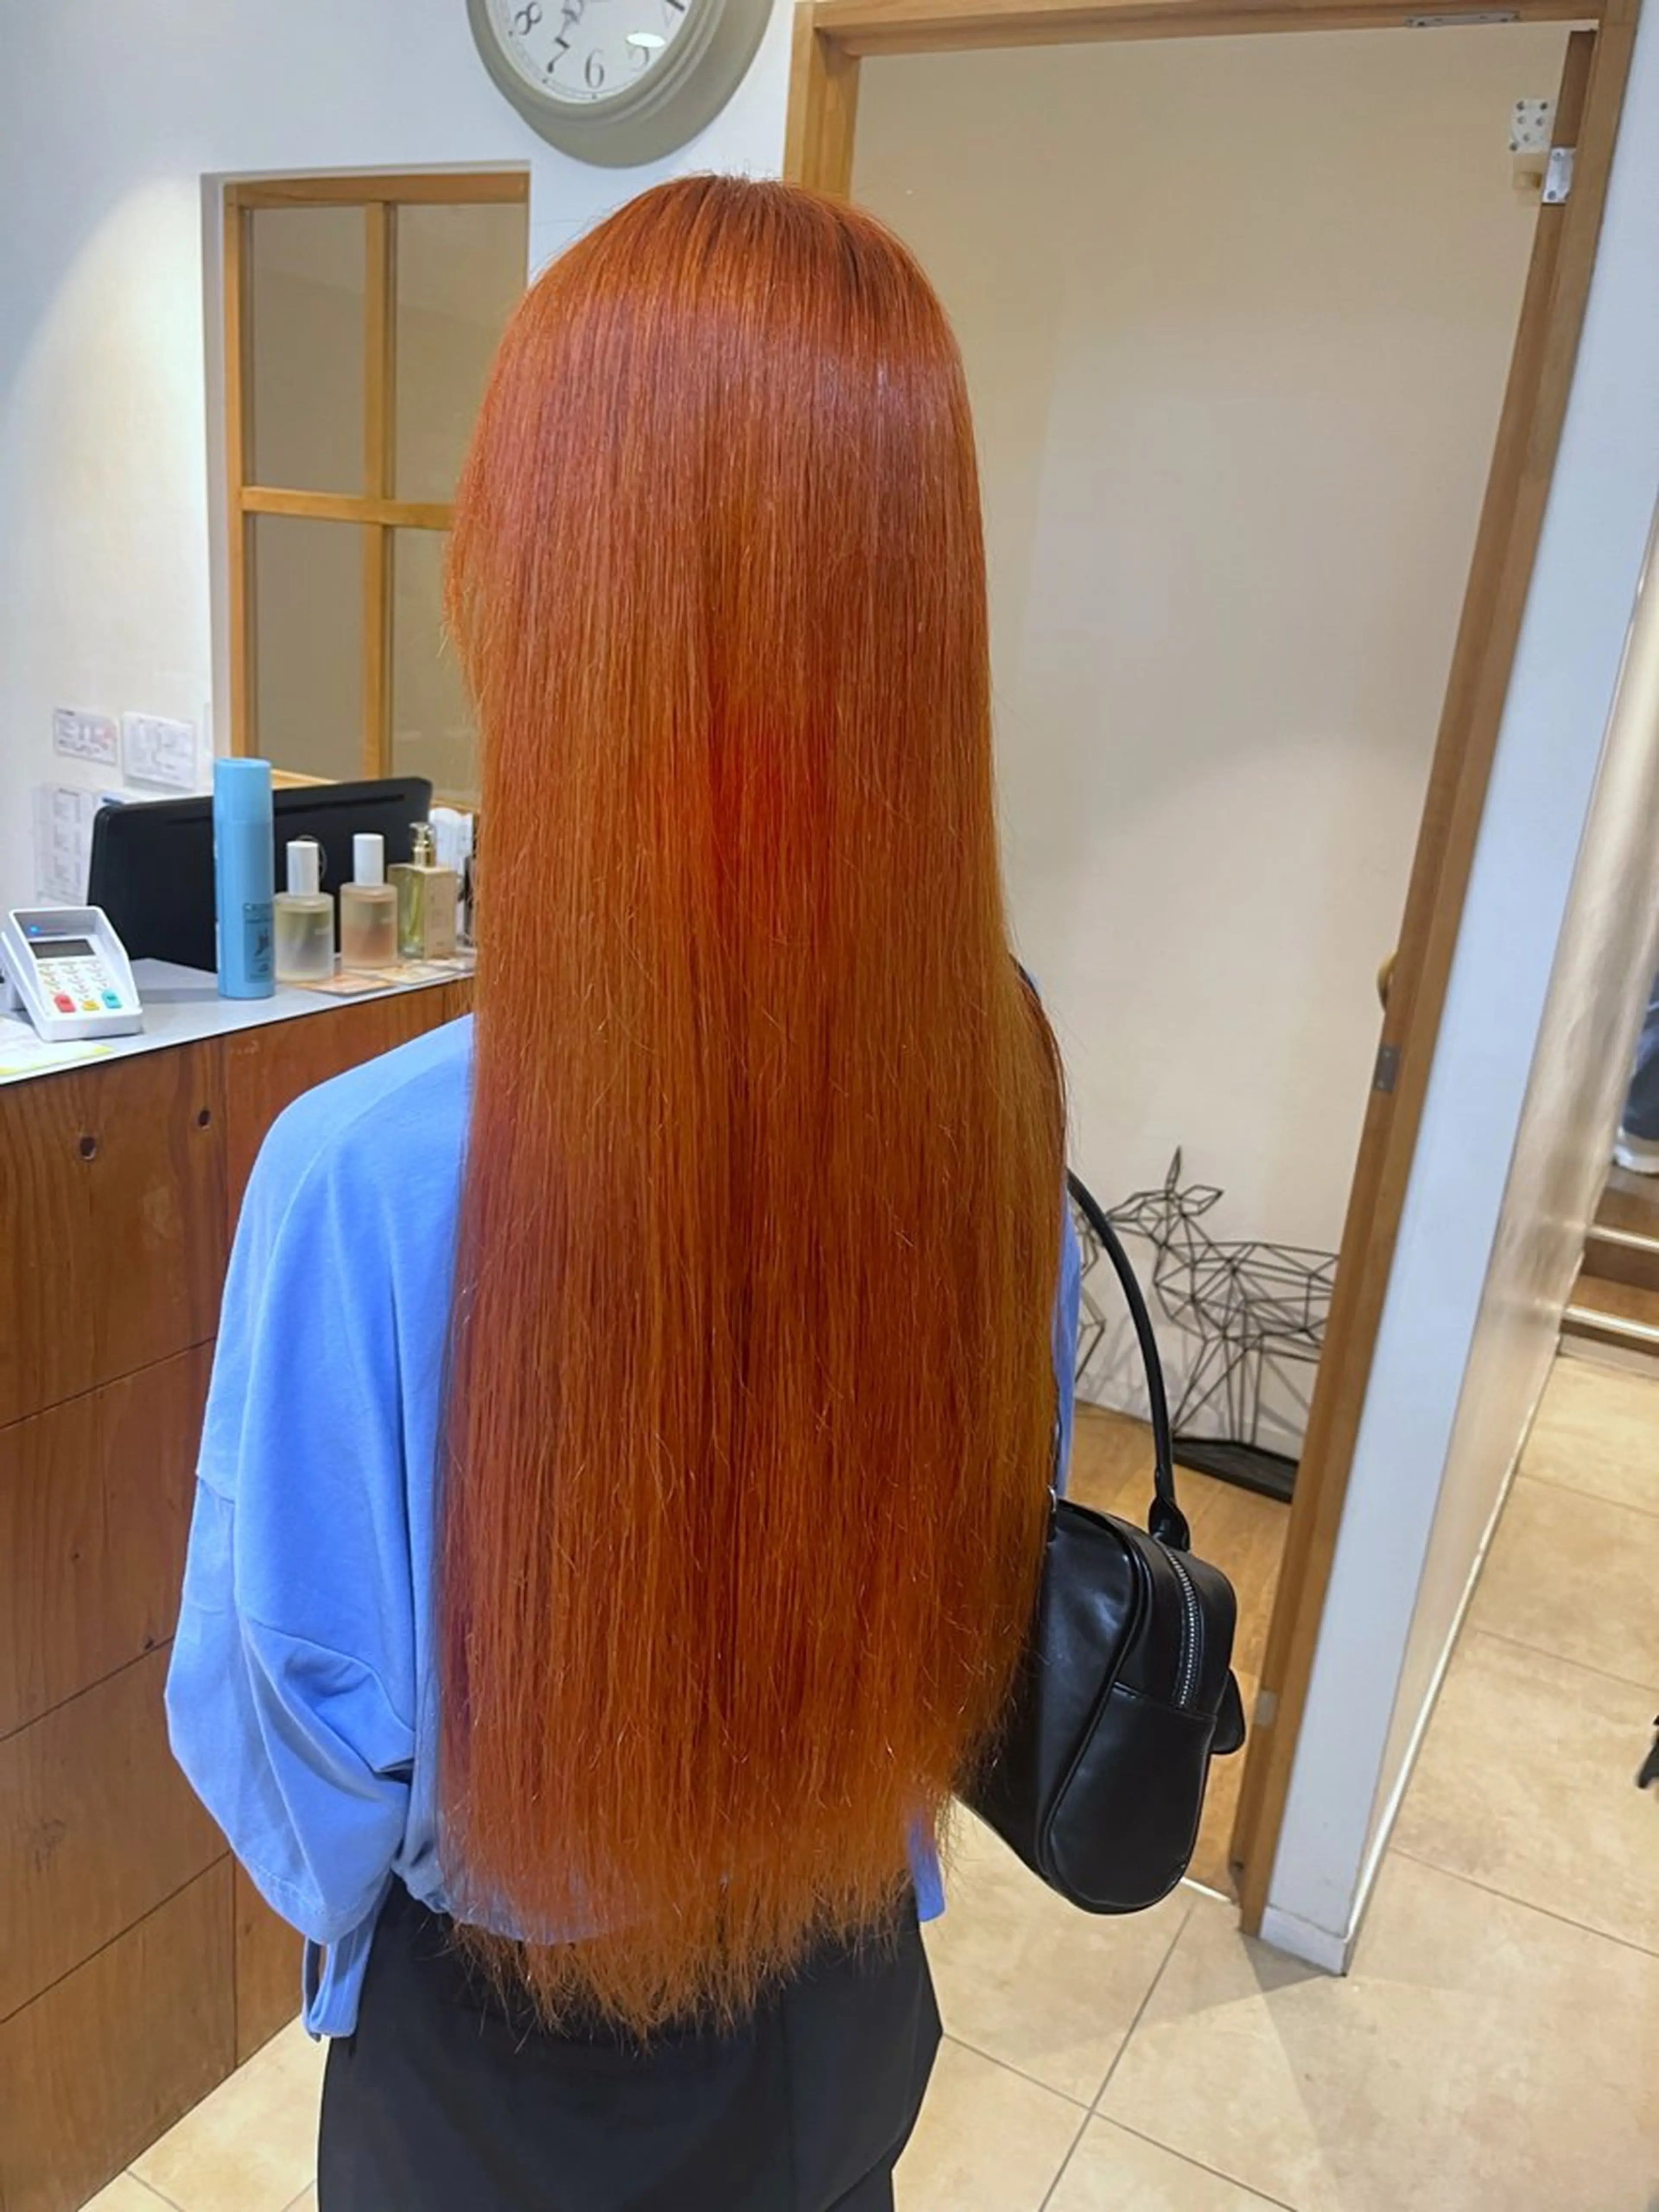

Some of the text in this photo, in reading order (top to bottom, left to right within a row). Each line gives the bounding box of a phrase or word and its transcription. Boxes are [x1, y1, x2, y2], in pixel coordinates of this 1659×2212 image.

[514, 2, 542, 35] 8
[547, 36, 570, 73] 7
[585, 48, 604, 88] 6
